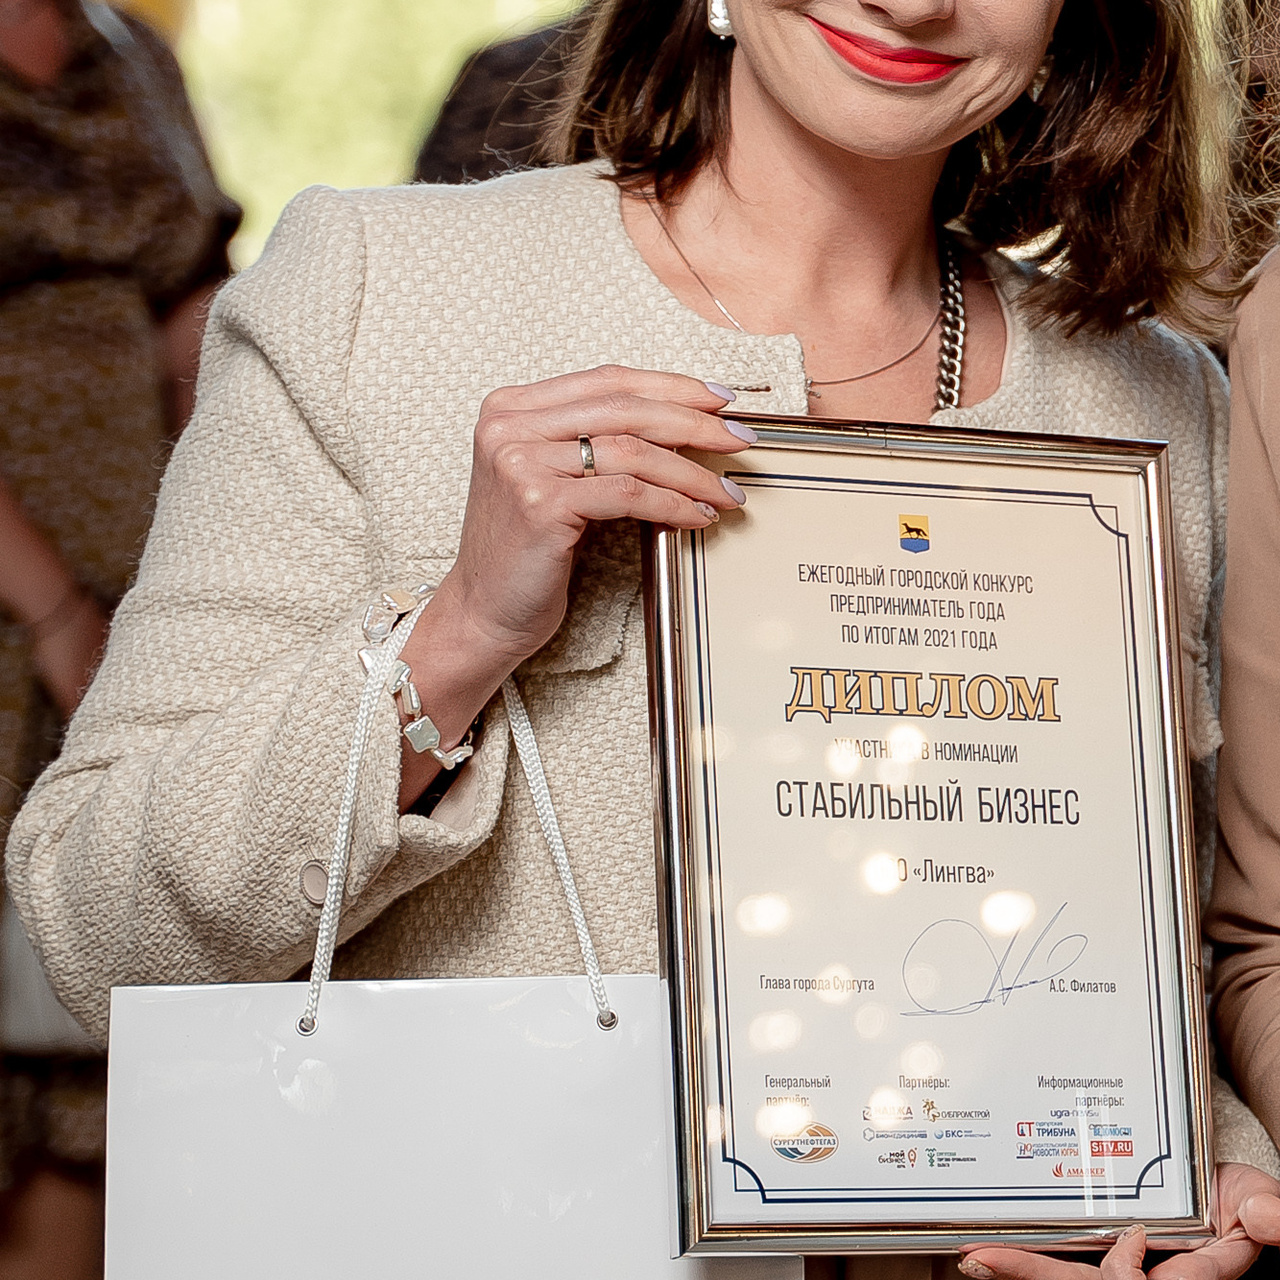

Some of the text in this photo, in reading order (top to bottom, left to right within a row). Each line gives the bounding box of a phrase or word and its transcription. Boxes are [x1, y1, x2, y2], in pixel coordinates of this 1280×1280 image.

[798, 563, 1034, 594] ЕЖЕГОДНЫЙ ГОРОДСКОЙ КОНКУРС
[830, 594, 1006, 623] ПРЕДПРИНИМАТЕЛЬ ГОДА
[841, 624, 998, 651] ПО ИТОГАМ 2021 ГОДА
[785, 666, 1061, 724] ДИПЛОМ
[921, 741, 930, 760] В
[934, 742, 1019, 765] НОМИНАЦИИ
[776, 778, 1081, 827] СТАБИЛЬНЫЙ БИЗНЕС
[912, 858, 995, 883] «Лингва»
[759, 974, 875, 995] Глава города Сургута
[1048, 978, 1117, 994] А.С. Филатов
[765, 1073, 831, 1089] Генеральный
[899, 1074, 951, 1090] Партнёры:
[1037, 1075, 1124, 1090] Информационные
[1075, 1094, 1125, 1109] партнёры:
[944, 1129, 964, 1139] БКС
[1036, 1127, 1076, 1137] ТРИБУНА
[773, 1137, 837, 1147] СУРГУТНЕФТЕГАЗ
[1091, 1141, 1132, 1152] SiTV.RU
[1033, 1148, 1079, 1157] НОВОСТИ ЮГРЫ
